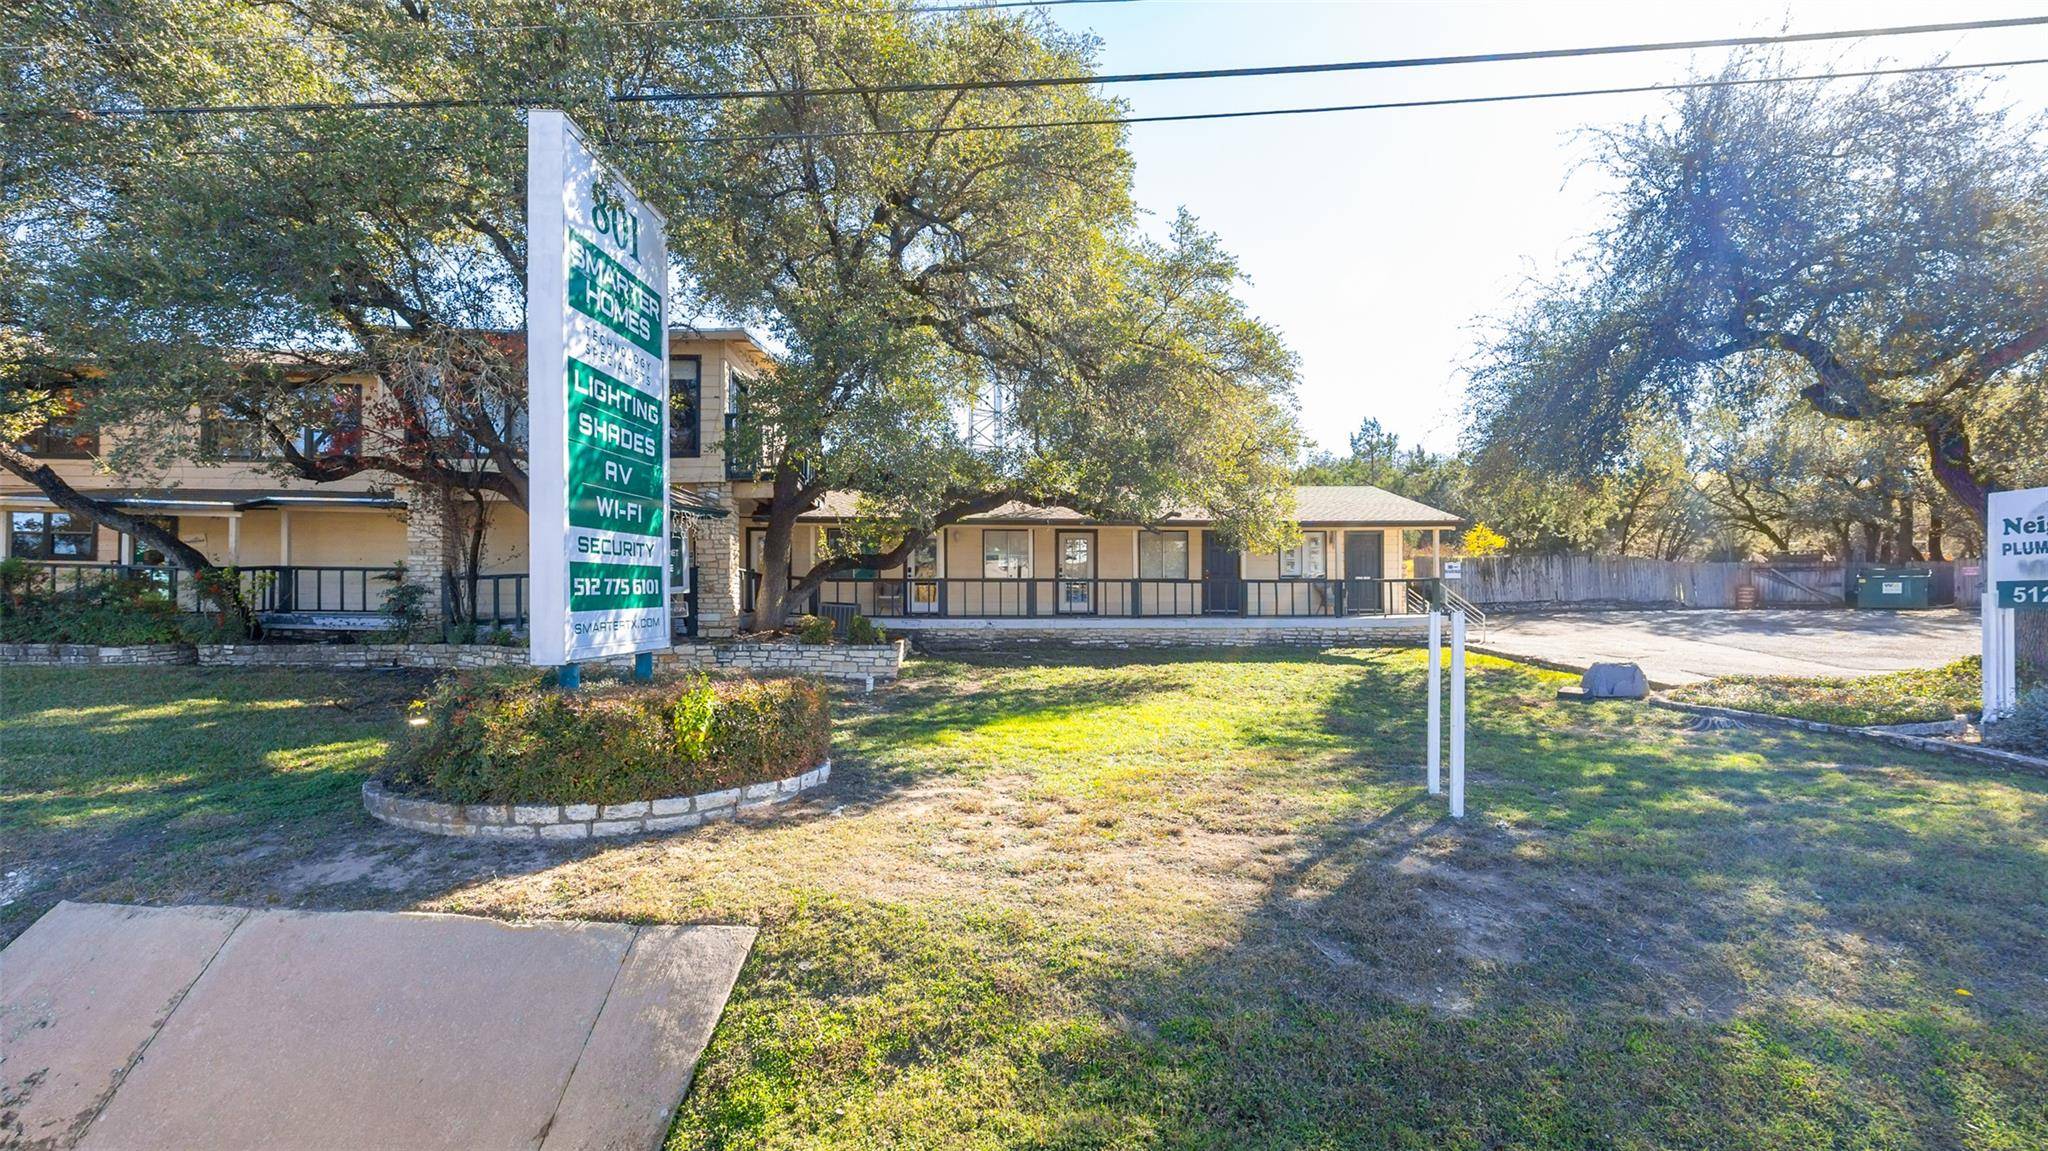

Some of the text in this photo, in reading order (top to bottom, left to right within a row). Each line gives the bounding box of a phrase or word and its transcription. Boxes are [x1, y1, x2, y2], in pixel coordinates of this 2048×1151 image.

[592, 183, 641, 264] 801
[569, 239, 660, 322] SMARTER
[585, 279, 651, 341] HOMES
[585, 325, 651, 370] TECHNOOGY
[574, 369, 659, 425] LIGHTING
[579, 412, 656, 457] SHADES
[605, 460, 633, 485] AV
[596, 495, 642, 523] WI-FI
[2003, 515, 2048, 536] Nei
[578, 535, 655, 558] SECURITY
[574, 577, 659, 596] 512 775 6101
